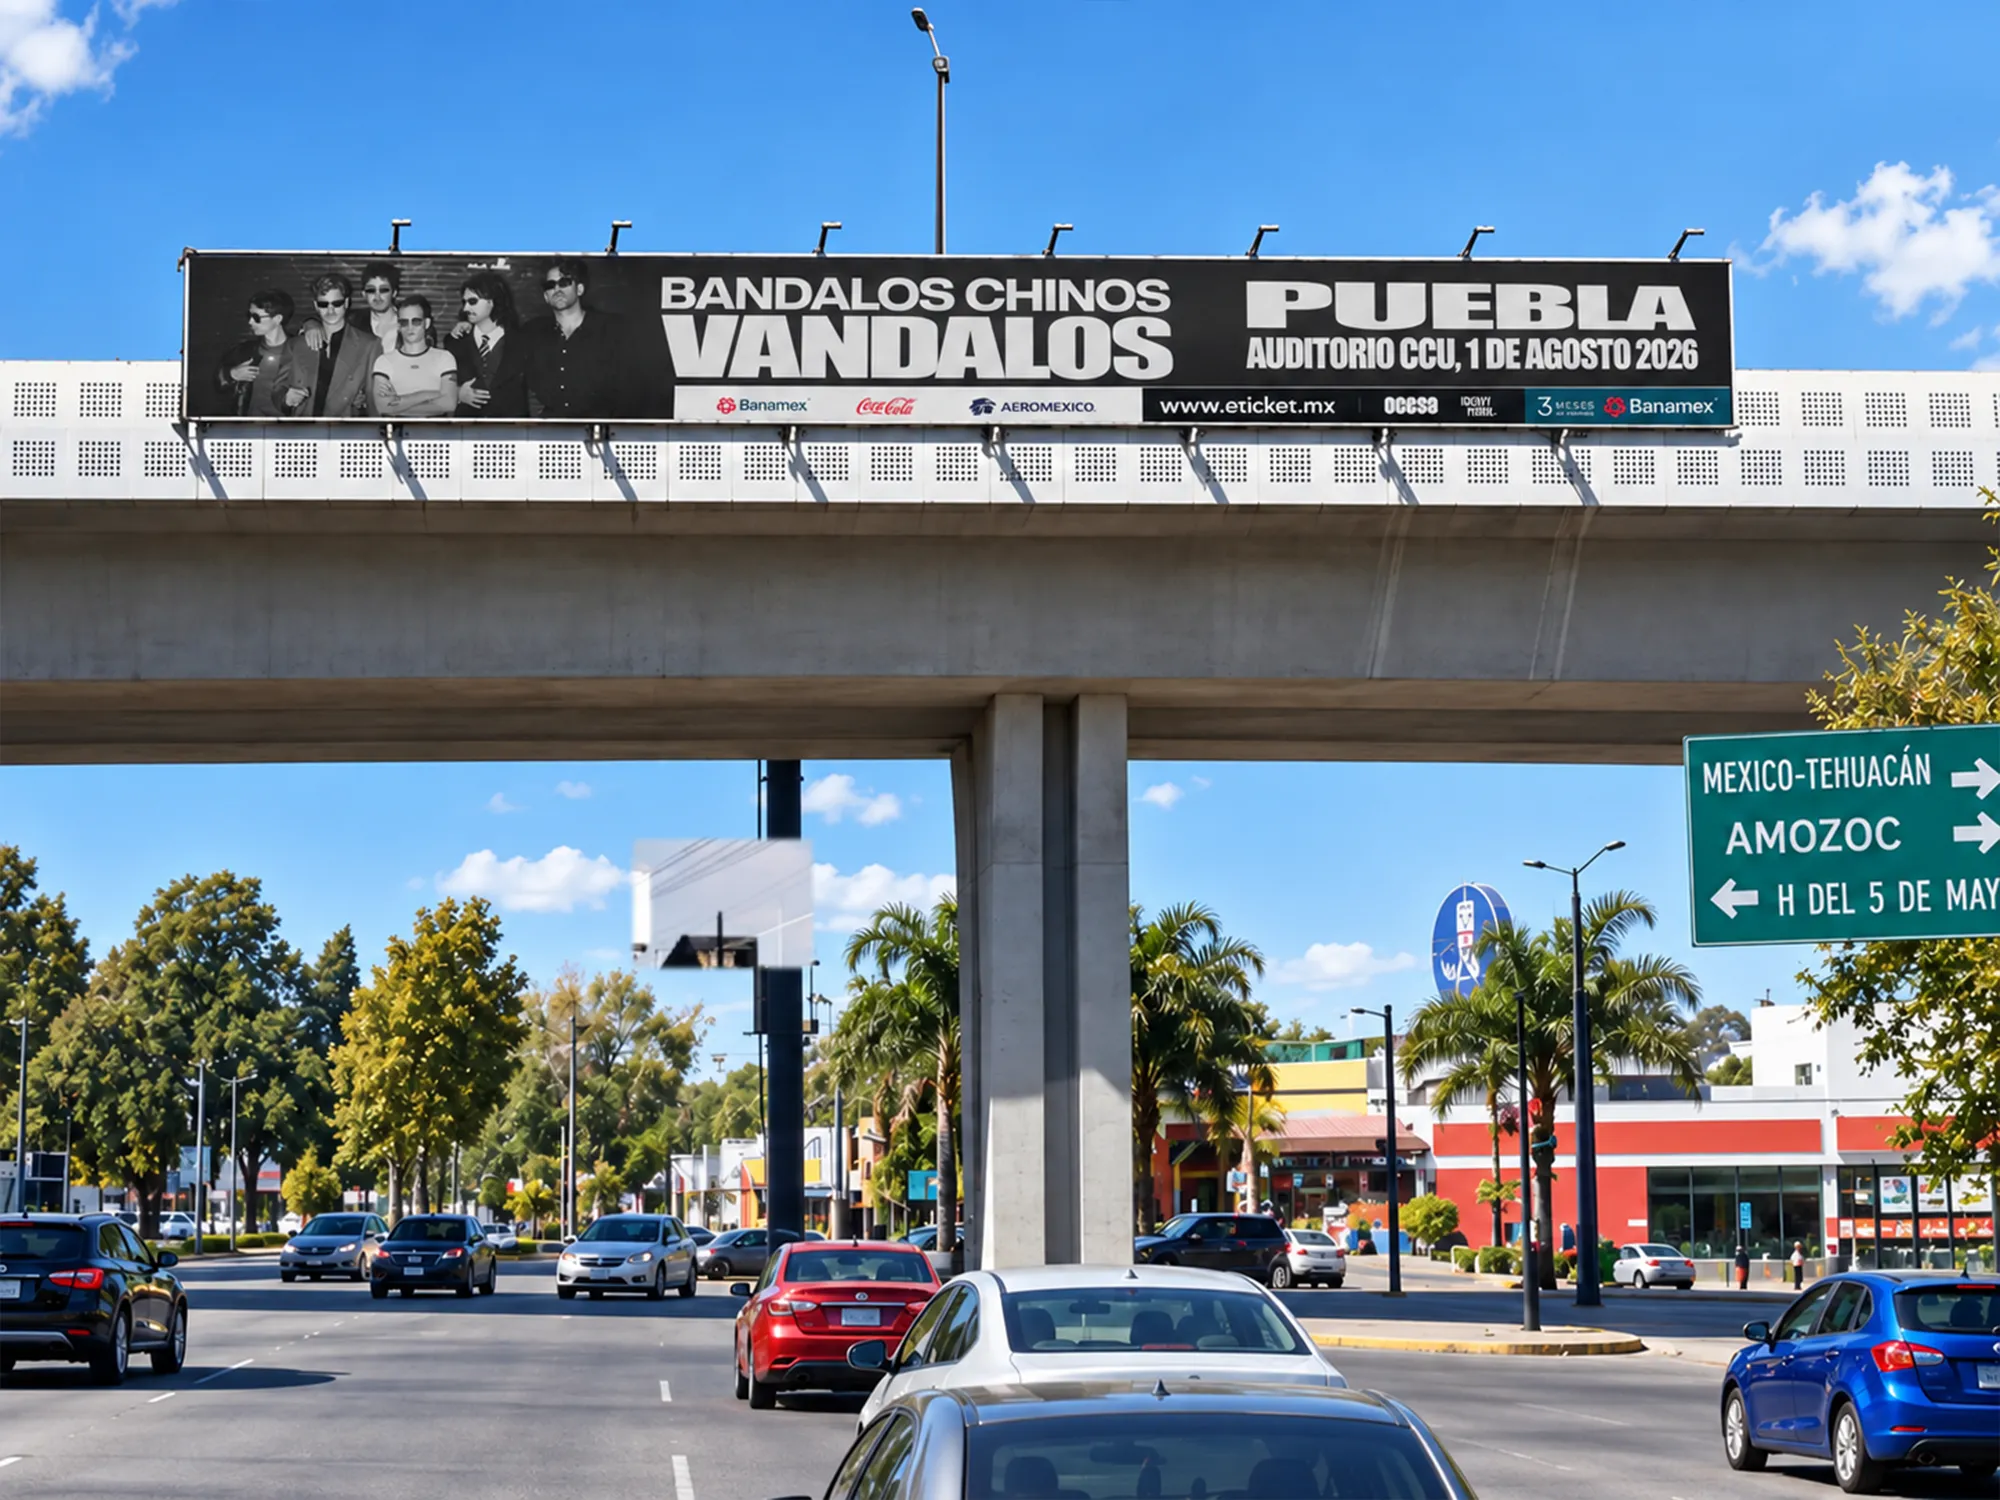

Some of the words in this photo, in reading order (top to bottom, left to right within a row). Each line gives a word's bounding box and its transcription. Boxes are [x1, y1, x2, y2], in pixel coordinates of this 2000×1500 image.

[660, 276, 956, 312] BANDALOS
[965, 277, 1171, 313] CHINOS
[1246, 280, 1697, 331] PUEBLA
[661, 314, 1174, 381] VANDALOS
[1246, 336, 1395, 370] AUDITORIO
[1399, 337, 1462, 373] CCU,
[1464, 337, 1479, 370] 1
[1485, 337, 1521, 370] DE
[1524, 337, 1632, 370] AGOSTO
[1635, 337, 1699, 370] 2026
[739, 398, 808, 412] Banamex
[1159, 395, 1336, 414] www.eticket.mx
[1384, 396, 1439, 415] ocesa
[1537, 396, 1553, 417] 3
[1629, 398, 1714, 414] Banamex
[1703, 744, 1931, 794] MEXICO-TEHUACÁN
[1725, 815, 1902, 855] AMOZOC
[1778, 883, 1795, 916] H
[1808, 882, 1856, 915] DEL
[1869, 881, 1885, 914] 5
[1898, 880, 1932, 913] DE
[1946, 877, 2000, 911] MAY
